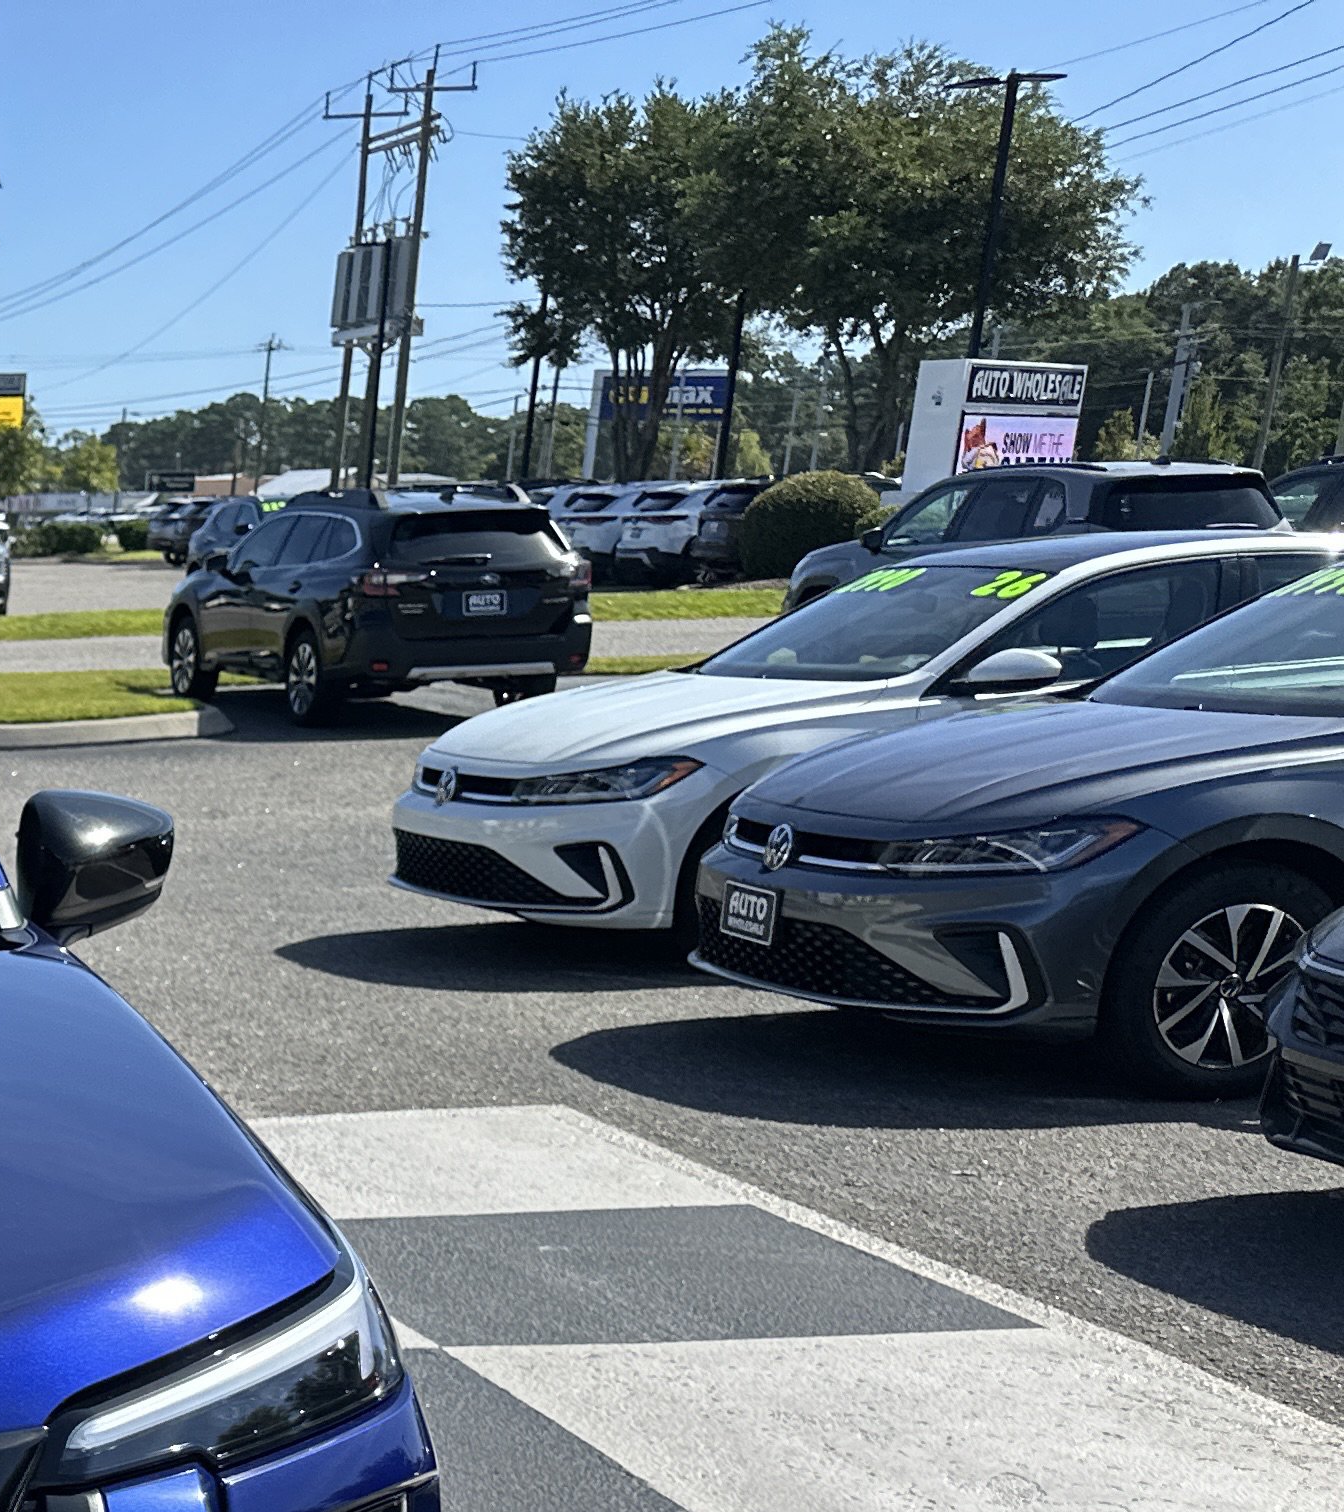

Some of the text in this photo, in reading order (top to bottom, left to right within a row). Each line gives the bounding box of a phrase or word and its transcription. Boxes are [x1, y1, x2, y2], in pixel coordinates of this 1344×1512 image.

[972, 370, 1083, 404] AUTO WHOLESALE
[1001, 432, 1032, 454] SHOW
[969, 570, 1047, 598] 26
[729, 890, 768, 920] AUTO
